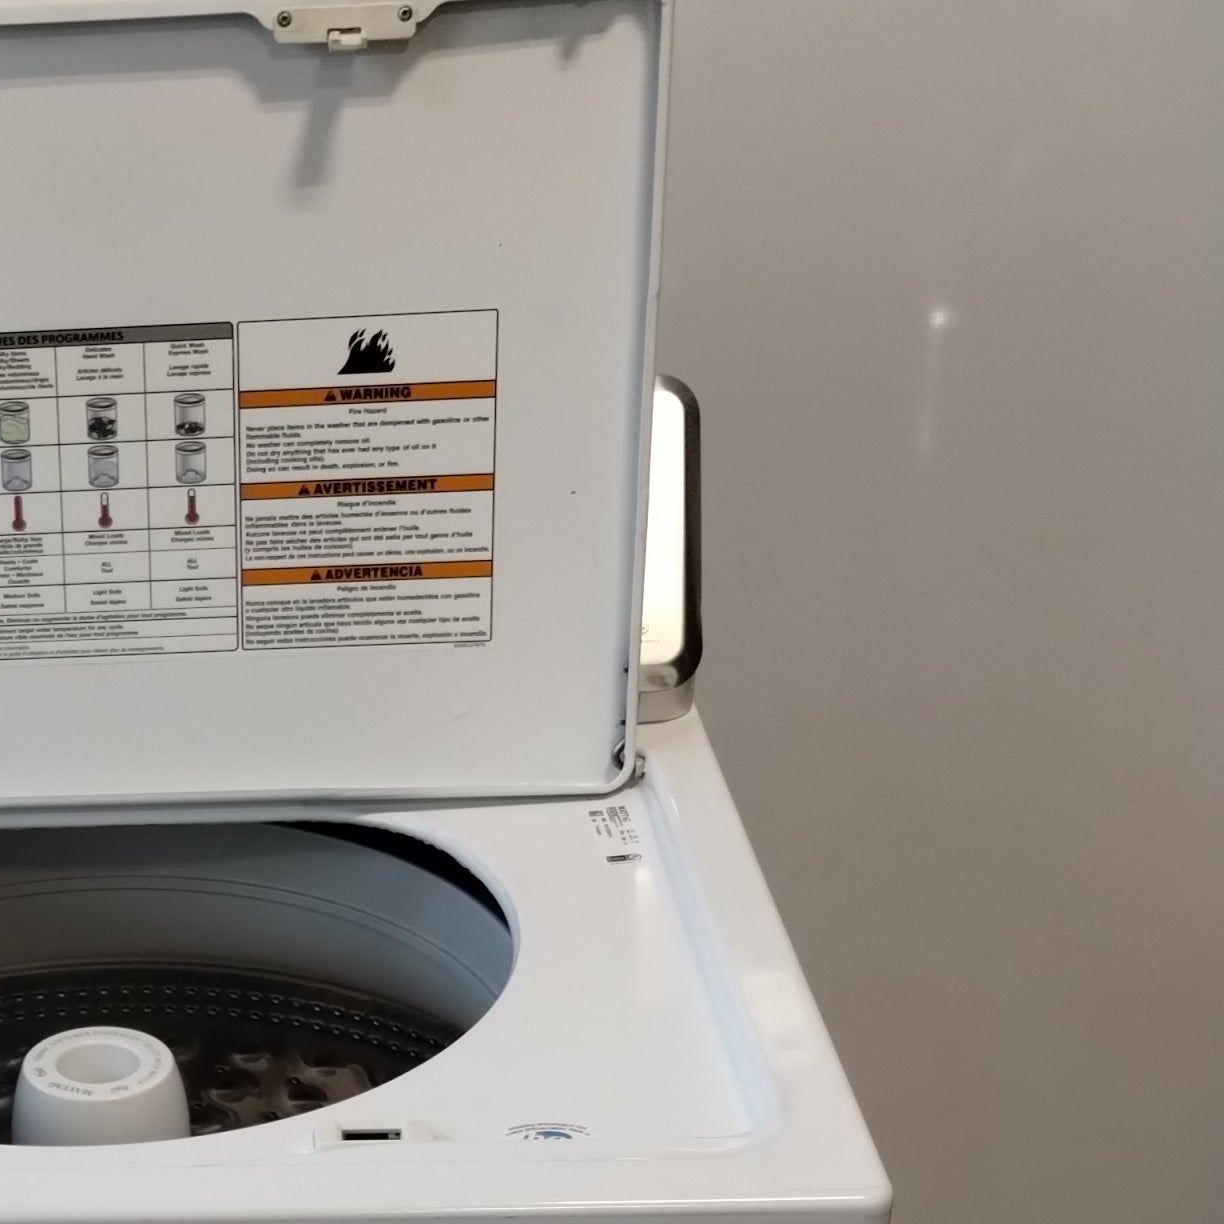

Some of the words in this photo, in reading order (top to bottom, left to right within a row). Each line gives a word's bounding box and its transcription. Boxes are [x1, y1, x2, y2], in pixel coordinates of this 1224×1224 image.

[17, 335, 38, 345] DES
[41, 331, 123, 343] PROGRAMMES
[340, 385, 411, 400] WARNING
[314, 479, 436, 494] AVERTISSEMENT
[325, 565, 422, 580] ADVERTENCIA
